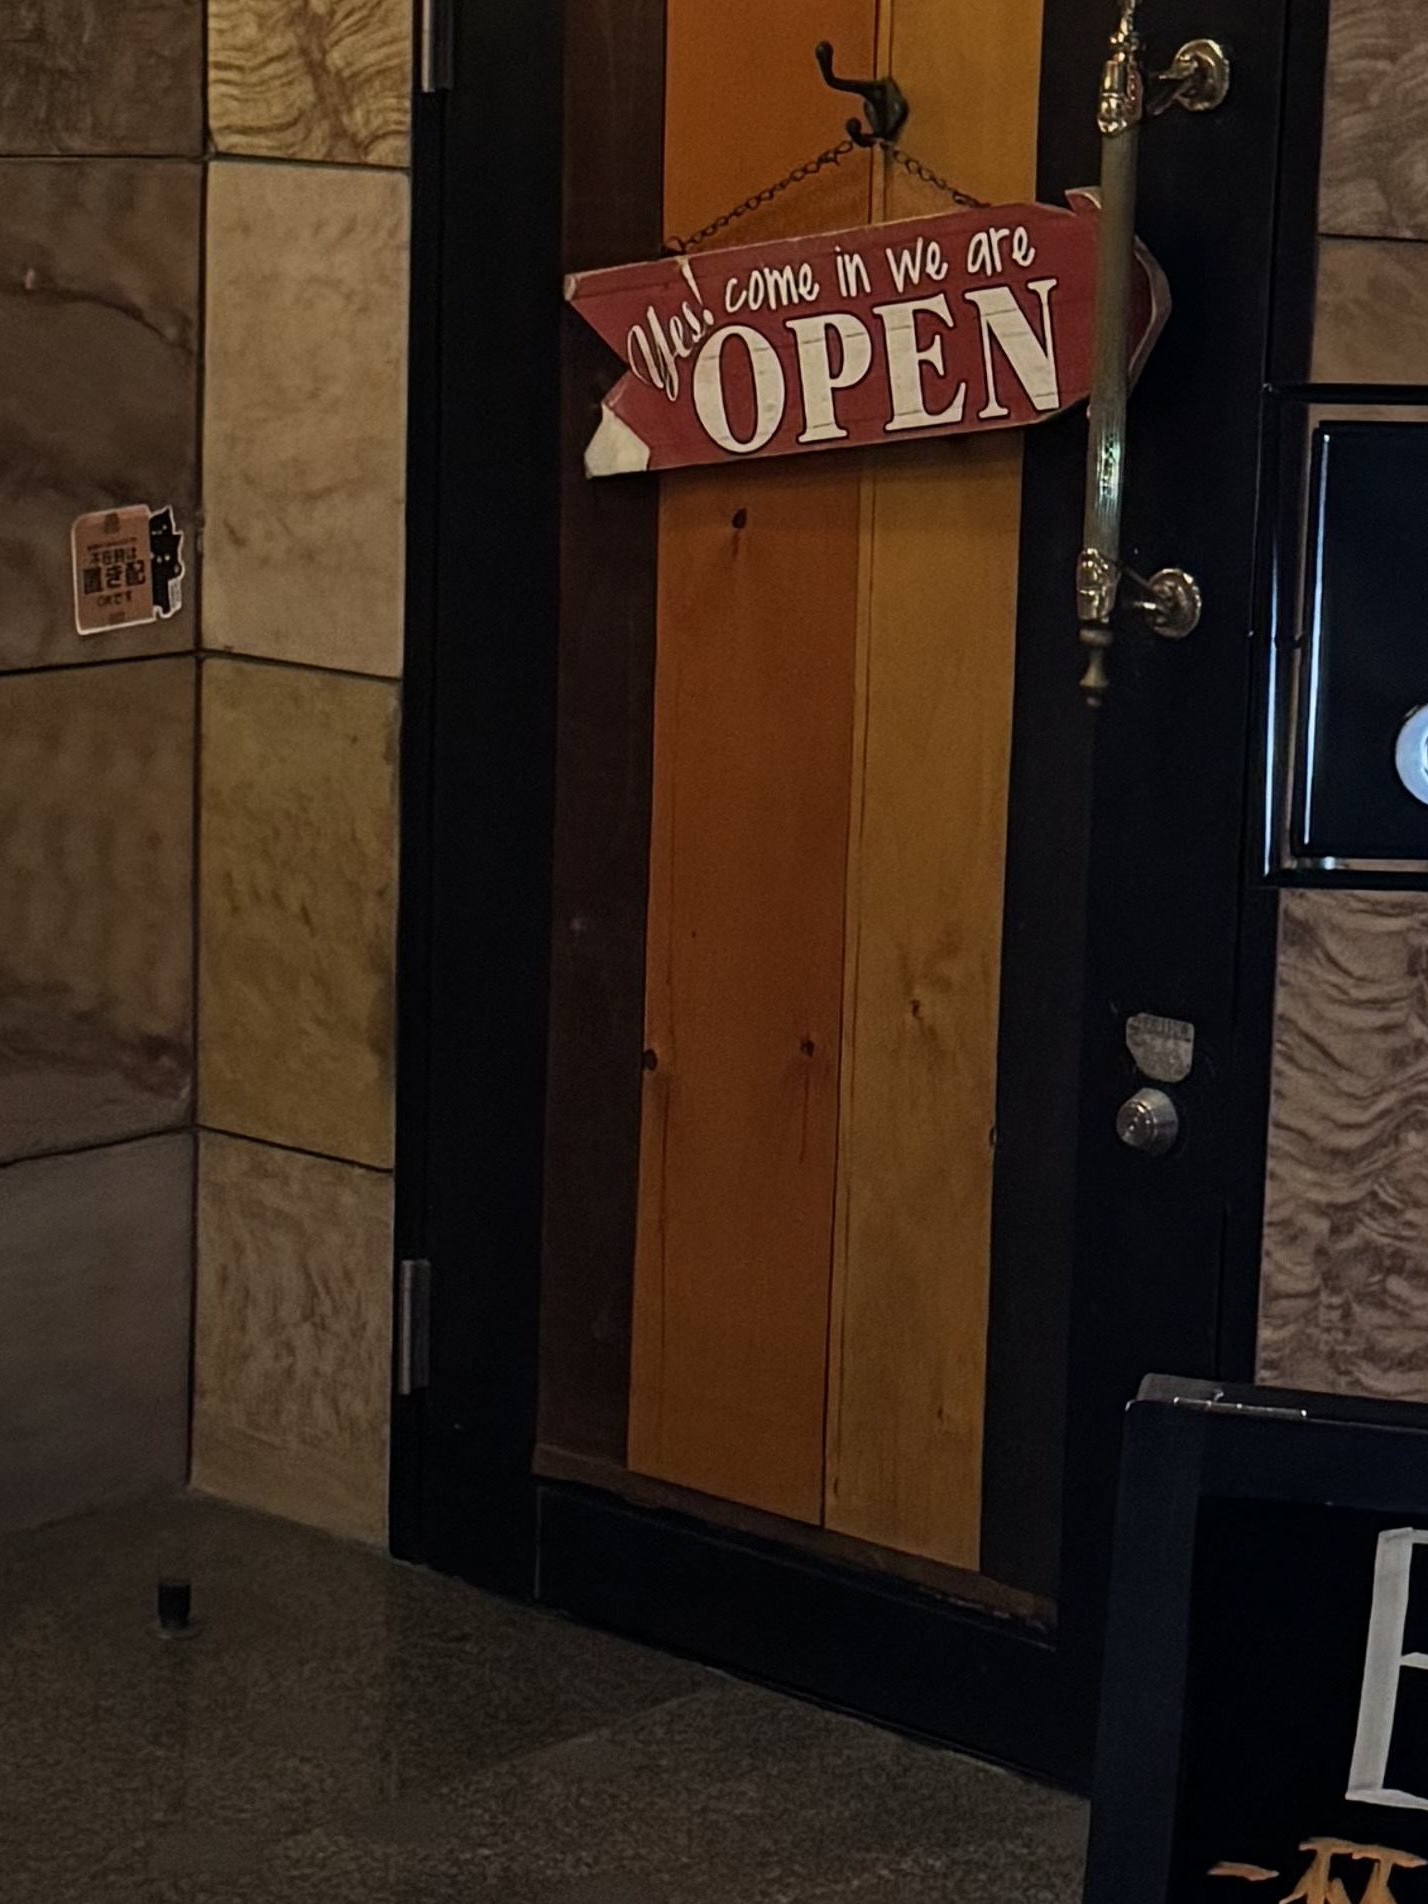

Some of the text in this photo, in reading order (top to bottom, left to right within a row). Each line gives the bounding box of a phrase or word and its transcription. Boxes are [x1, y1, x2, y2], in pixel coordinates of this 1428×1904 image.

[625, 255, 717, 401] Yes!
[725, 259, 819, 314] come
[836, 246, 871, 298] in
[966, 225, 1036, 277] are
[692, 279, 1060, 453] OPEN
